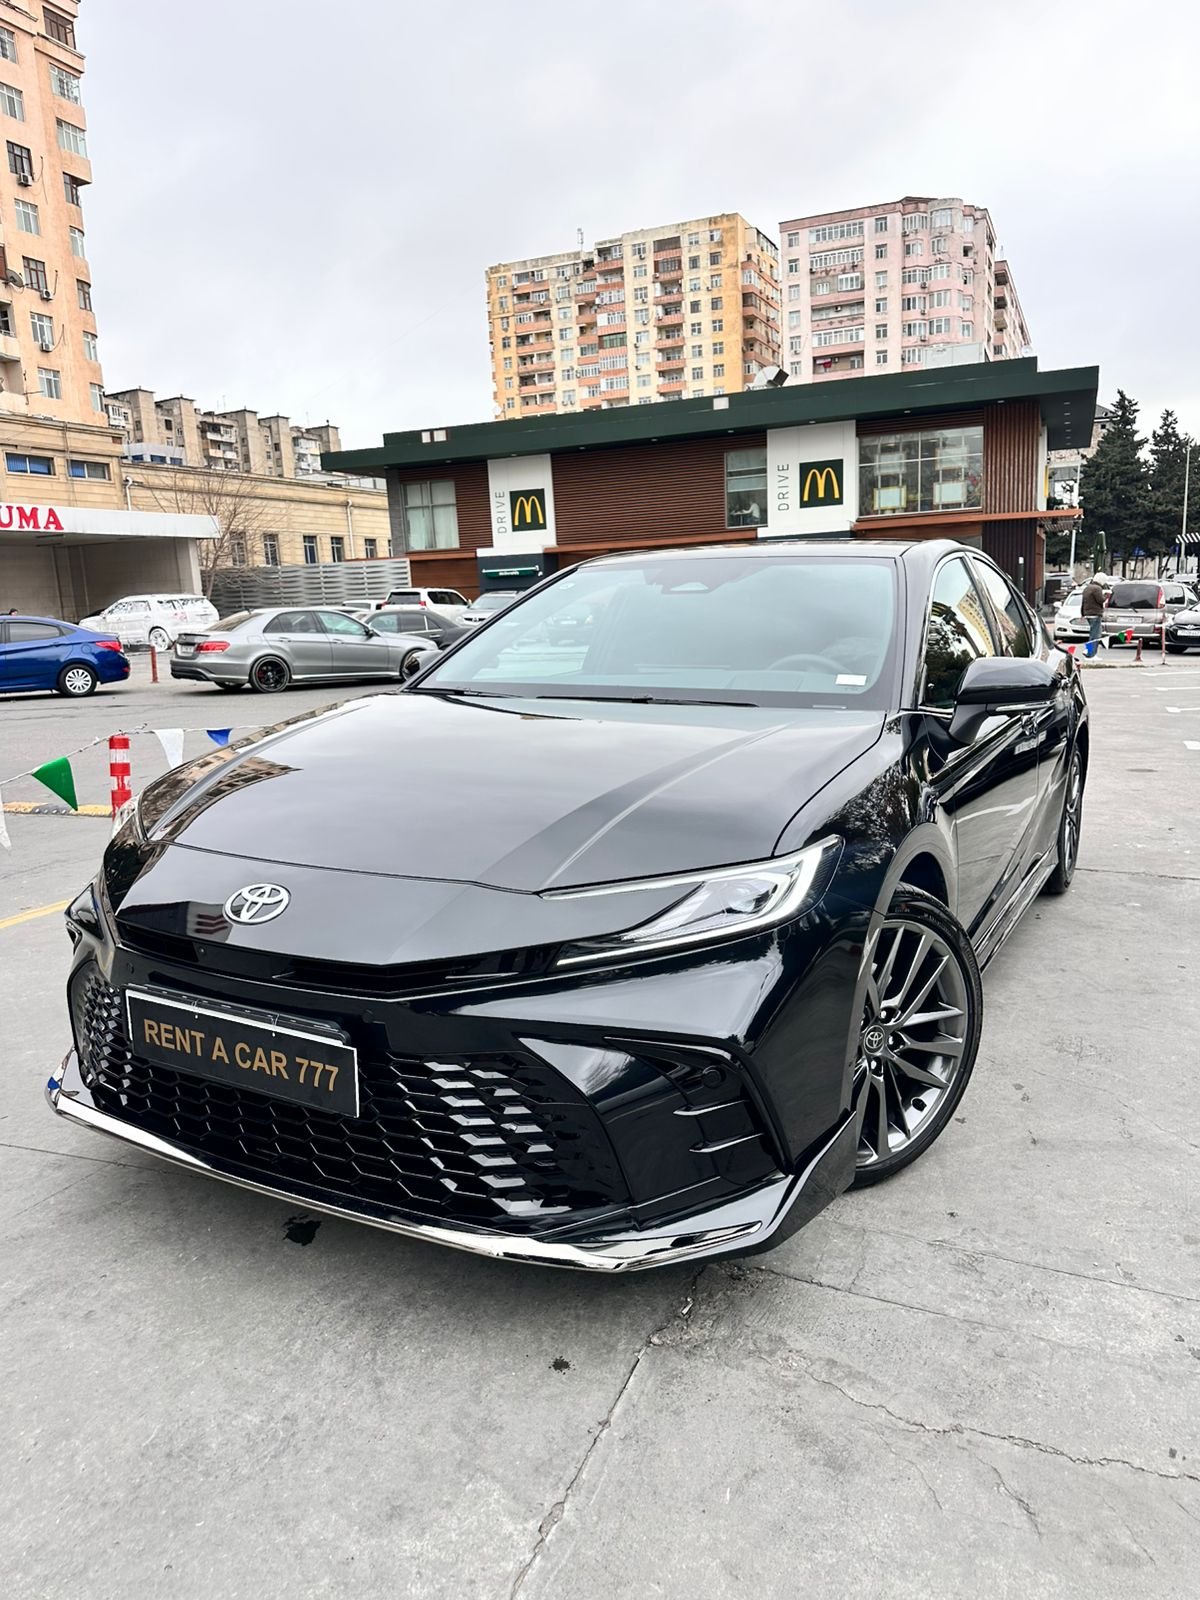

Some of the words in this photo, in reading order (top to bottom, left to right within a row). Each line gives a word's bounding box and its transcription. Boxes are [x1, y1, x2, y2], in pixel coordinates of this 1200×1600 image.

[777, 464, 790, 511] DRIVE
[495, 491, 508, 534] DRIVE
[143, 1018, 205, 1057] RENT
[211, 1037, 230, 1064] A
[234, 1042, 290, 1080] CAR
[295, 1056, 339, 1092] 777
